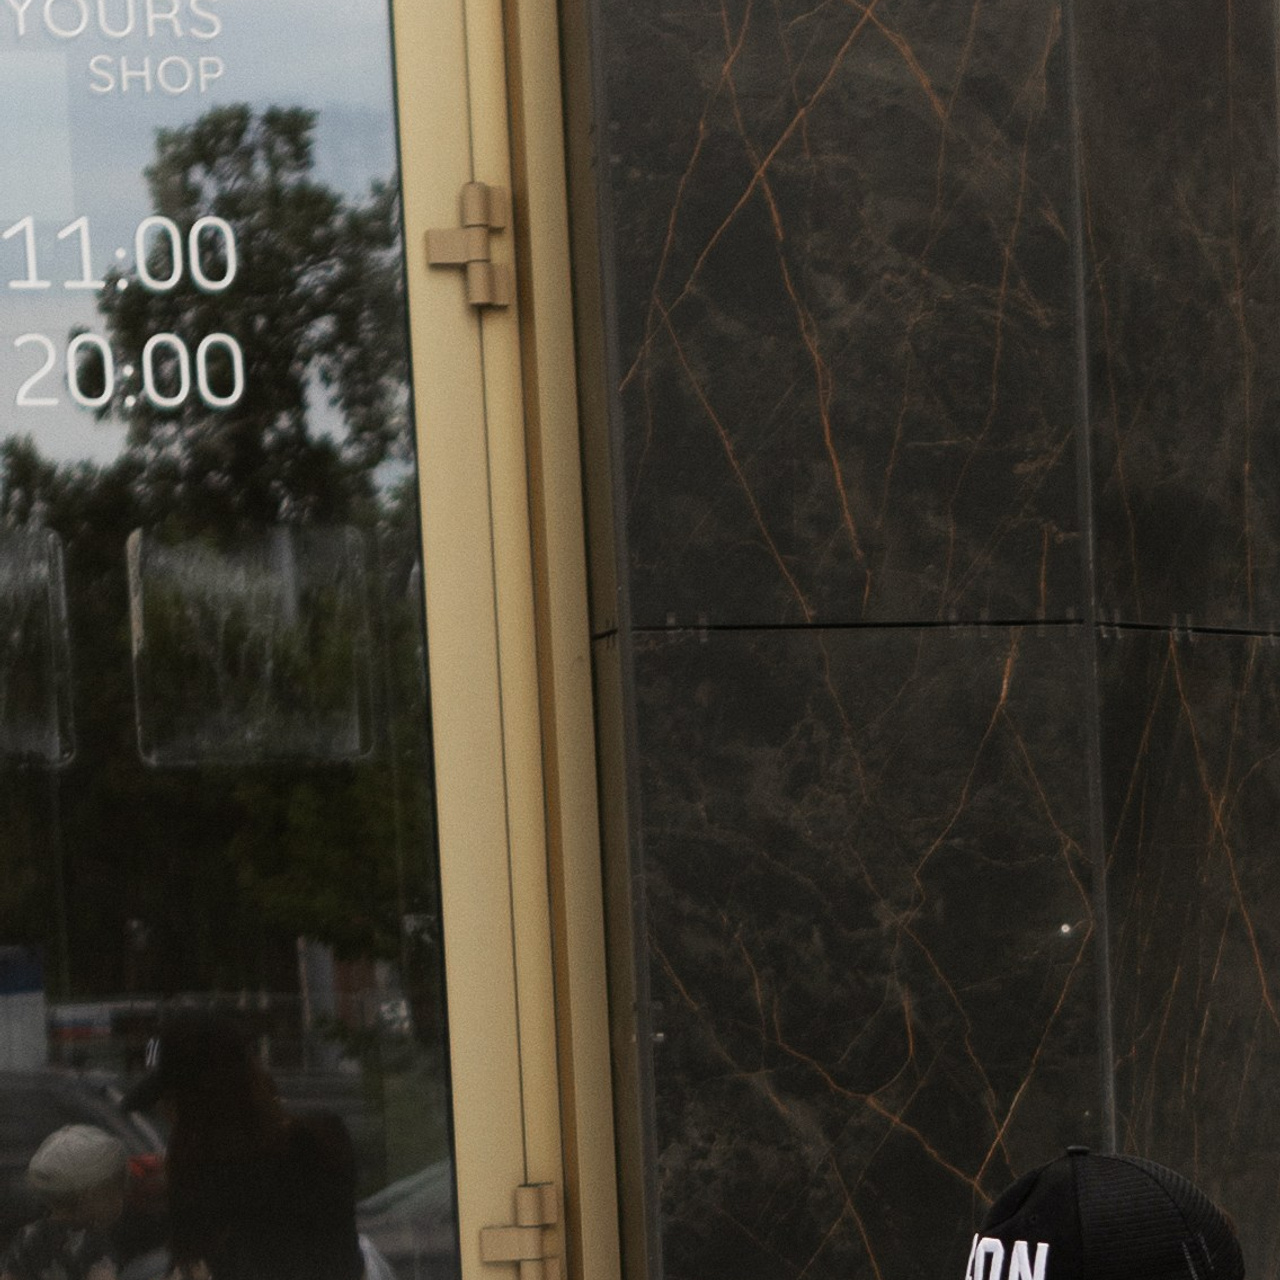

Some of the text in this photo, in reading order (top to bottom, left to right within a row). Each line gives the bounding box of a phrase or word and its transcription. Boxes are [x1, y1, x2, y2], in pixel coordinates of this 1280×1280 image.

[7, 0, 222, 38] YOURS
[89, 55, 224, 92] SHOP
[2, 216, 237, 290] 11:00
[13, 333, 245, 407] 20:00
